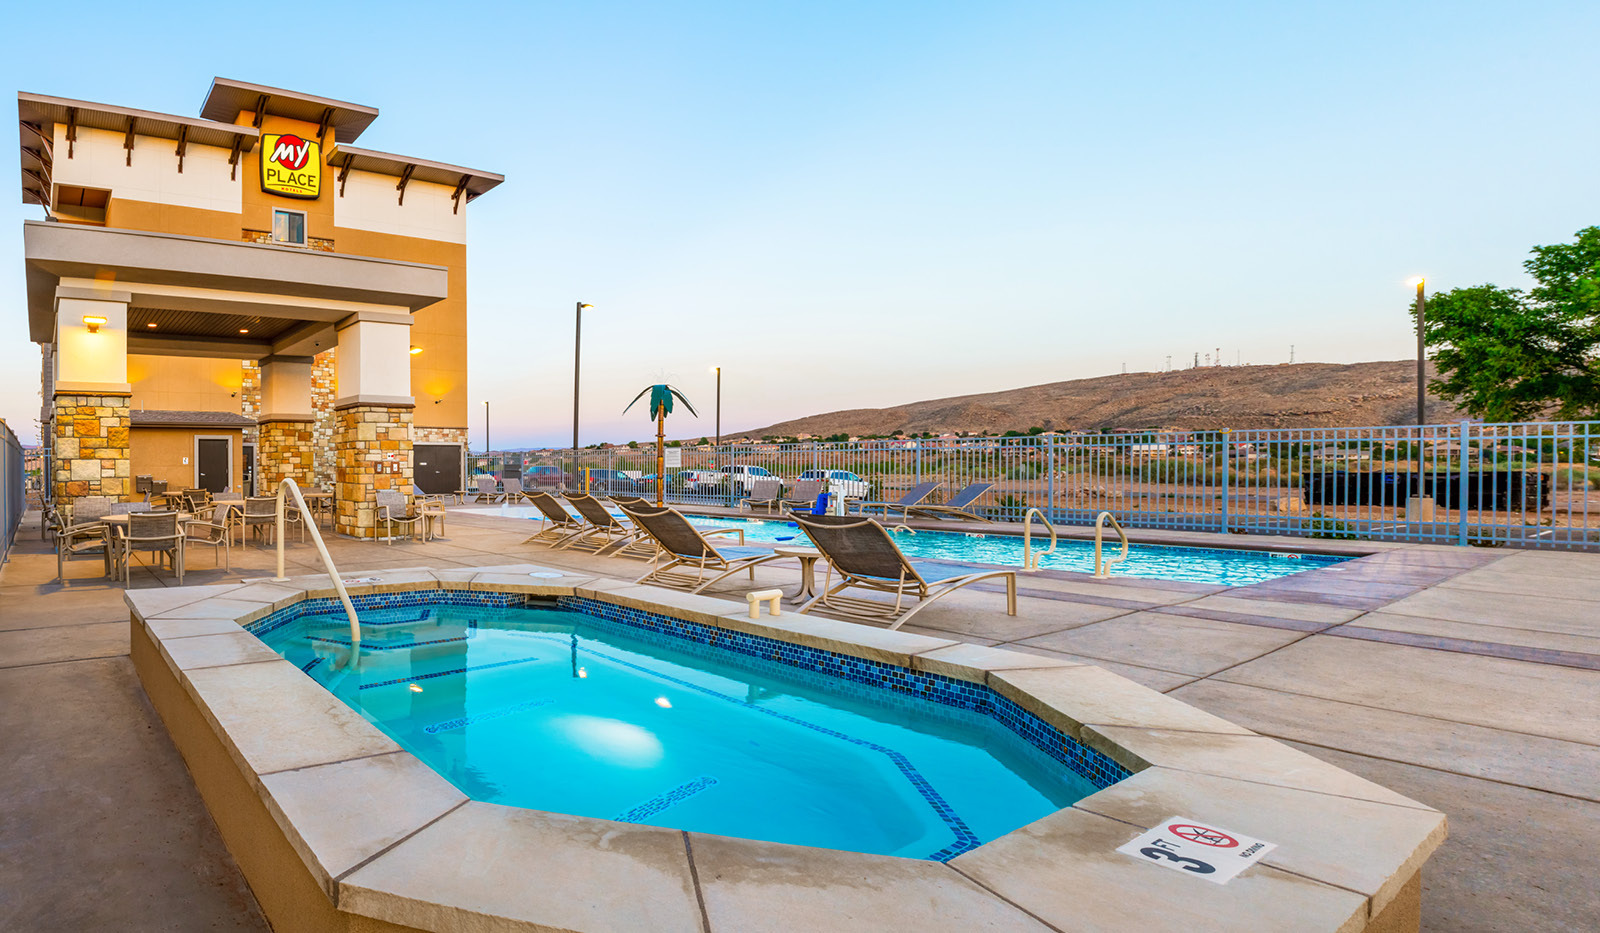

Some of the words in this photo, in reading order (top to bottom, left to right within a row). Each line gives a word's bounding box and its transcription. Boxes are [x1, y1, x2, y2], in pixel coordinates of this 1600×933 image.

[267, 168, 316, 188] PLACE
[1151, 838, 1181, 852] FT
[1140, 847, 1216, 874] 3
